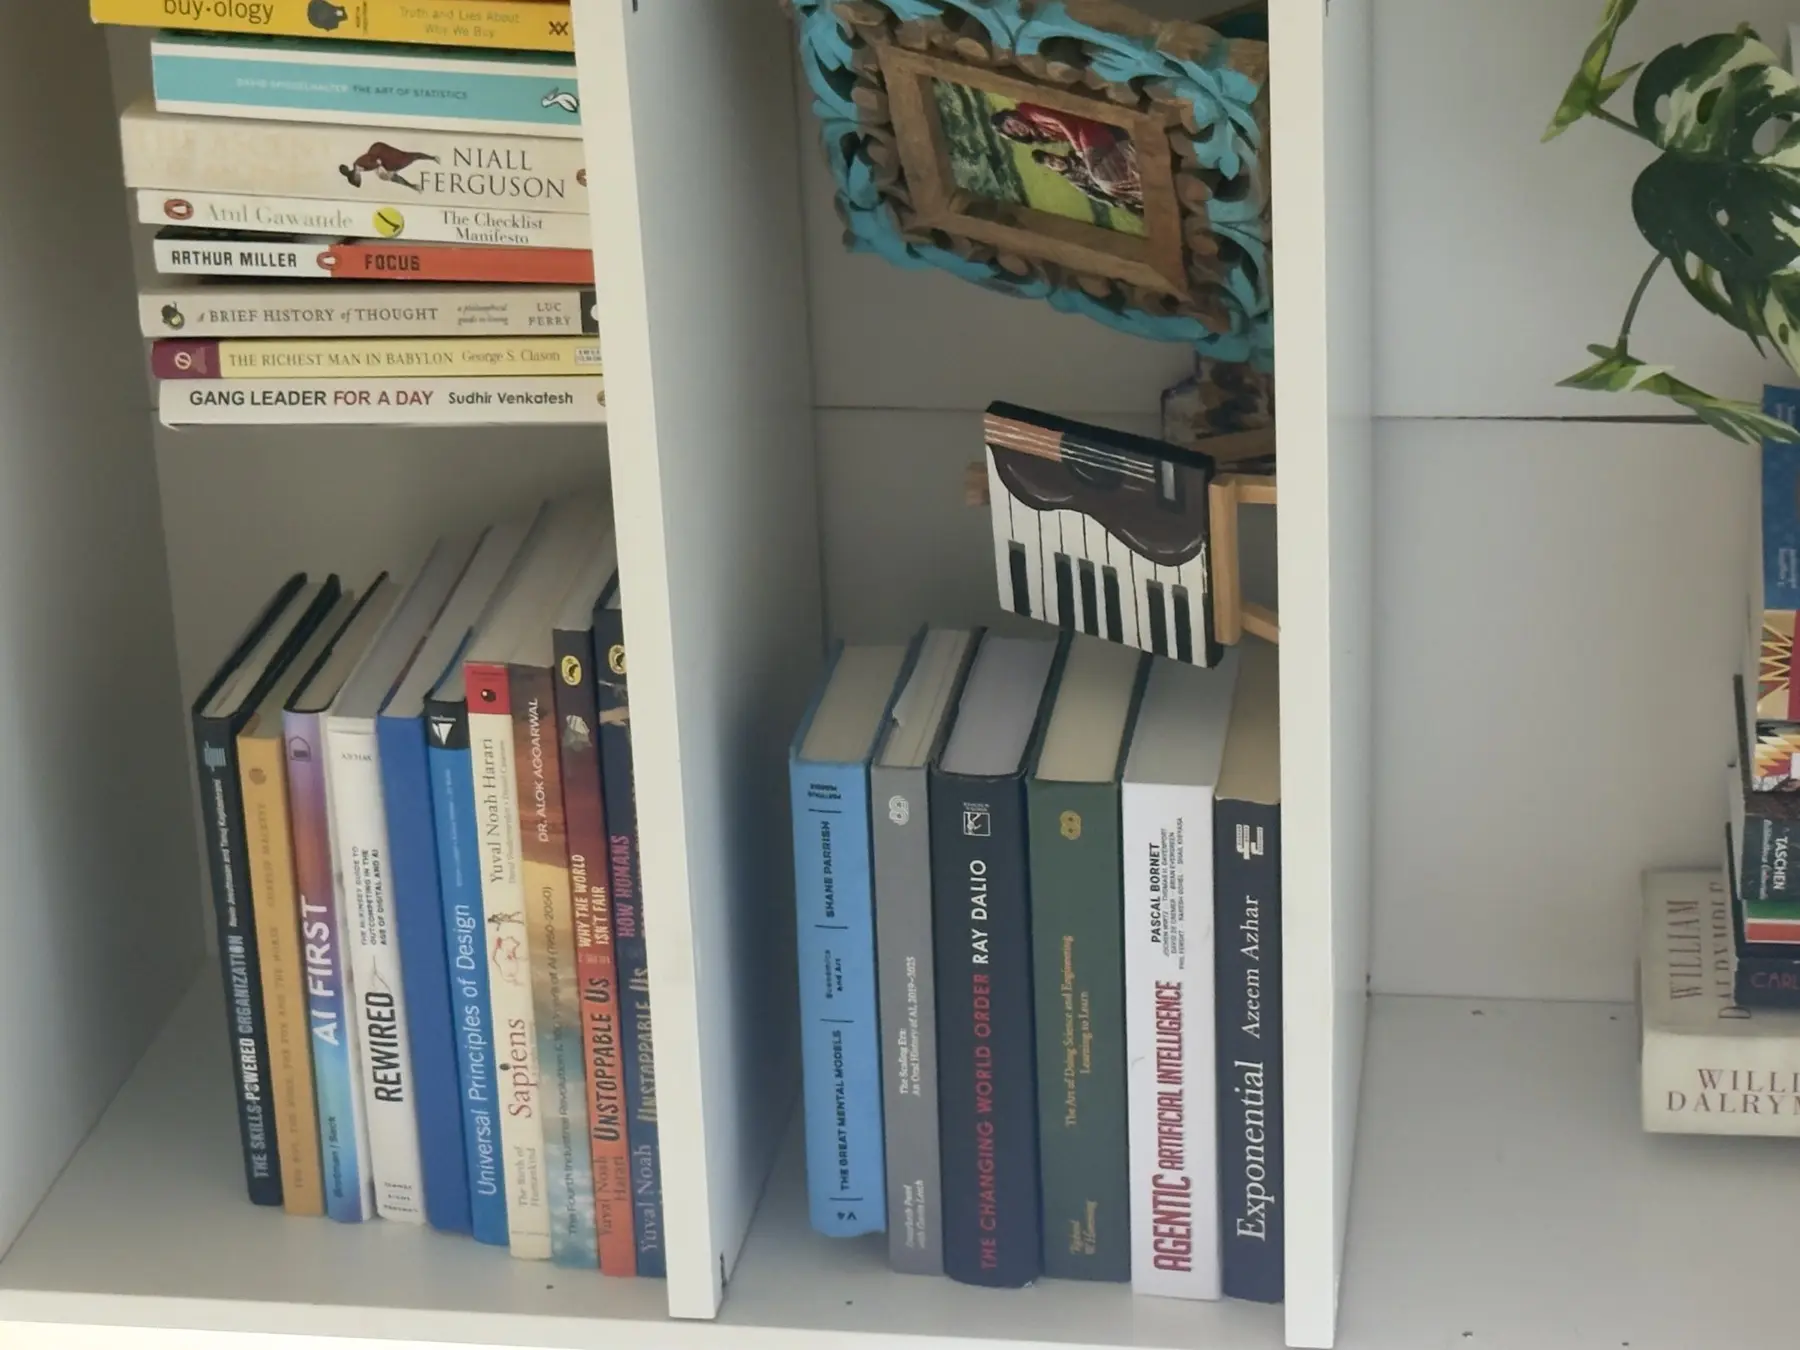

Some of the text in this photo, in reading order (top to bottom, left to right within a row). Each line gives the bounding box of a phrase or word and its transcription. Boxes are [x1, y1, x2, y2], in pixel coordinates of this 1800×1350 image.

[453, 25, 469, 37] We
[352, 84, 468, 100] THE ART OF STATISTICS
[453, 147, 533, 171] NIALL
[419, 171, 565, 199] FERGUSON
[206, 203, 353, 229] Atul Gawande
[443, 210, 545, 230] The Checklist
[455, 227, 530, 244] Manifesto
[172, 250, 297, 268] ARTHUR MILLER
[364, 254, 421, 271] FOCUS
[209, 310, 258, 323] BRIEF
[264, 309, 335, 322] HISTORY
[340, 310, 351, 323] of
[355, 307, 438, 321] THOUGHT
[528, 315, 571, 327] FERRY
[536, 302, 562, 312] LUC
[229, 351, 453, 366] THE RICHEST MAN IN BABYLON
[462, 351, 503, 366] George
[520, 349, 560, 362] Clason
[189, 390, 434, 405] GANG LEADER FOR A DAY
[448, 391, 573, 405] Sudhir Venkatesh
[526, 697, 551, 842] DR. ALOK AGGARWAL
[480, 738, 504, 884] Yuval Noah Harari
[351, 845, 359, 857] TO
[610, 834, 632, 897] HUMANS
[819, 820, 835, 918] SHANE PARRISH
[1773, 835, 1789, 891] TASCHEN
[353, 860, 361, 885] GUIDE
[361, 849, 377, 945] OUTCOMPETING IN THE
[370, 849, 387, 946] AGE OF DIGITAL AND AI
[571, 854, 592, 948] WHY THE WORLD
[590, 885, 607, 912] FAIR
[968, 859, 990, 965] RAY DALIO
[1148, 842, 1162, 943] PASCAL BORNET
[360, 931, 368, 946] THE
[452, 904, 477, 969] Design
[592, 917, 610, 945] ISN'T
[615, 903, 636, 938] HOW
[546, 957, 557, 970] AI
[1239, 894, 1262, 1039] Azeem Azhar
[1666, 900, 1704, 1000] WILLIAM
[228, 935, 254, 1034] ORGANIZATION
[300, 894, 340, 1047] AI FIRST
[457, 976, 478, 997] of
[547, 972, 557, 983] of
[832, 958, 844, 992] and Art
[908, 1017, 917, 1027] of
[1060, 935, 1078, 1127] The Art of Doing Science and Engineering
[1077, 991, 1093, 1074] Learning to Learn
[364, 991, 404, 1102] REWIRED
[462, 1005, 488, 1101] Principles
[909, 1031, 920, 1061] History
[501, 1018, 537, 1119] Sapiens
[555, 1053, 568, 1115] Revolution
[898, 1046, 909, 1094] The Scaling
[910, 1063, 919, 1081] Oral
[911, 1084, 921, 1096] An
[831, 1030, 850, 1190] THE GREAT MENTAL MODELS
[971, 972, 997, 1270] THE CHANGING WORLD ORDER
[1151, 980, 1193, 1273] AGENTIC ARTIFICIAL INTELLIGENCE
[470, 1108, 498, 1195] Universal
[561, 1117, 573, 1171] Industrial
[1232, 1059, 1276, 1243] Exponential
[251, 1154, 270, 1178] THE
[527, 1146, 540, 1206] Humankind
[611, 1156, 627, 1201] Harari
[517, 1189, 529, 1207] The
[565, 1173, 576, 1212] Fourth
[593, 1156, 612, 1236] Yuval Noah
[633, 1144, 657, 1253] Yuval Noah
